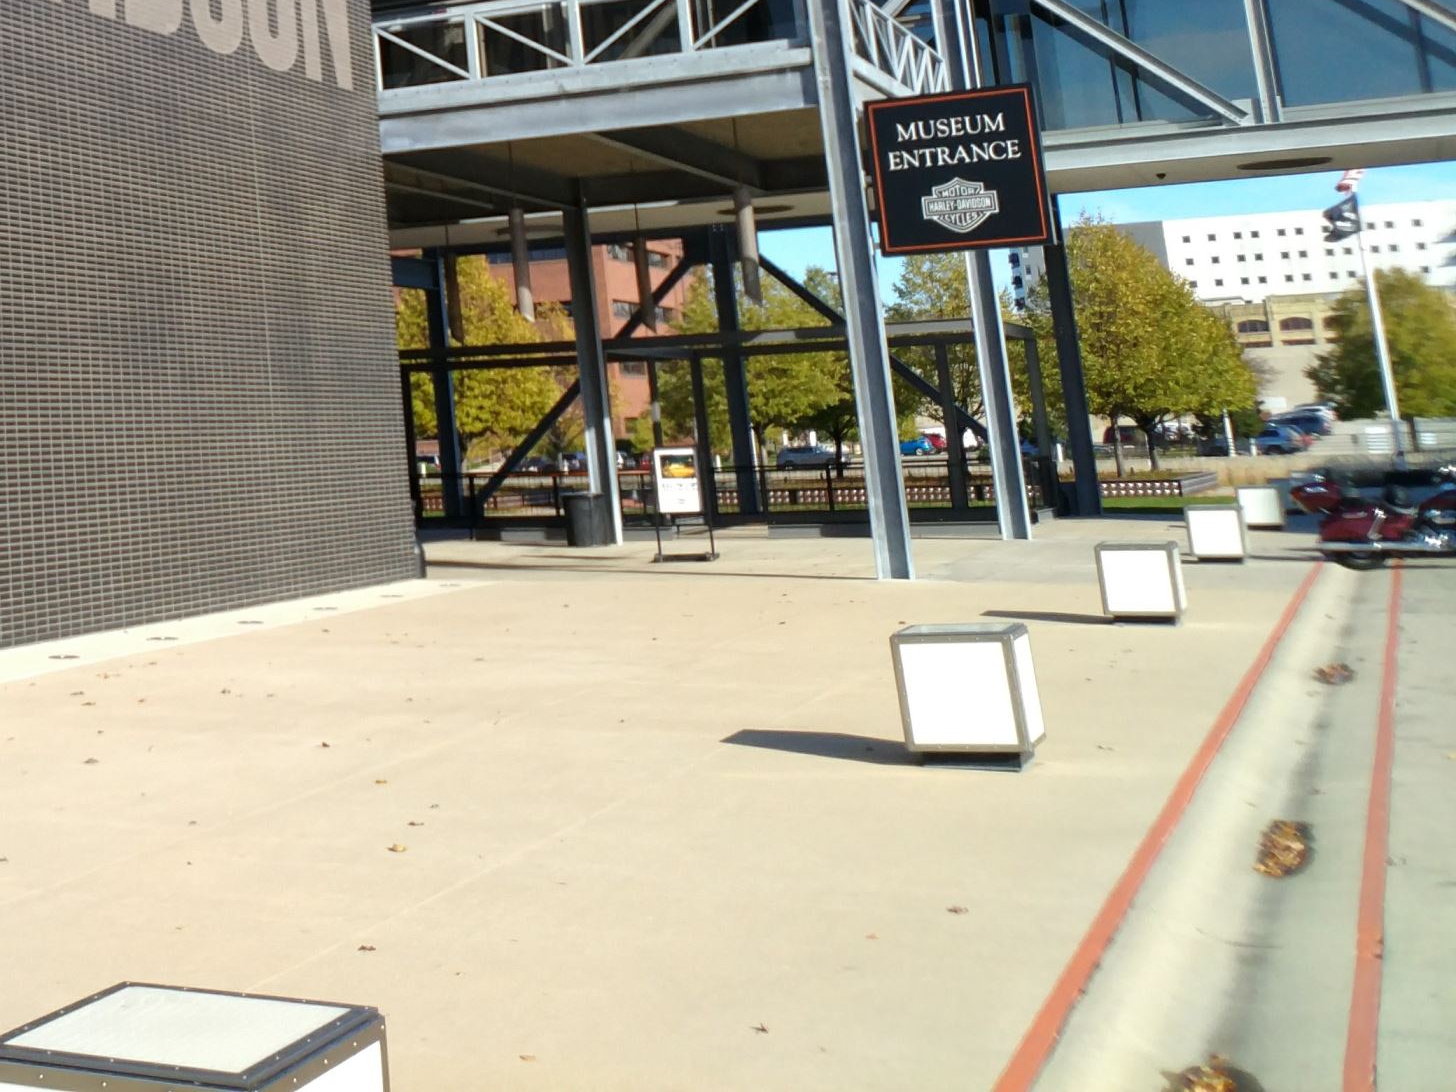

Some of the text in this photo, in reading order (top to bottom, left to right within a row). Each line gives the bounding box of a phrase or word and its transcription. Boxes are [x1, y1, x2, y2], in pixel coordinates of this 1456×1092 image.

[896, 112, 1006, 143] MUSEUM
[888, 140, 1022, 172] ENTRANCE
[942, 185, 975, 198] MOTOR
[928, 197, 991, 213] HARLEY-DAVIDSON
[944, 212, 978, 226] CYCLES
